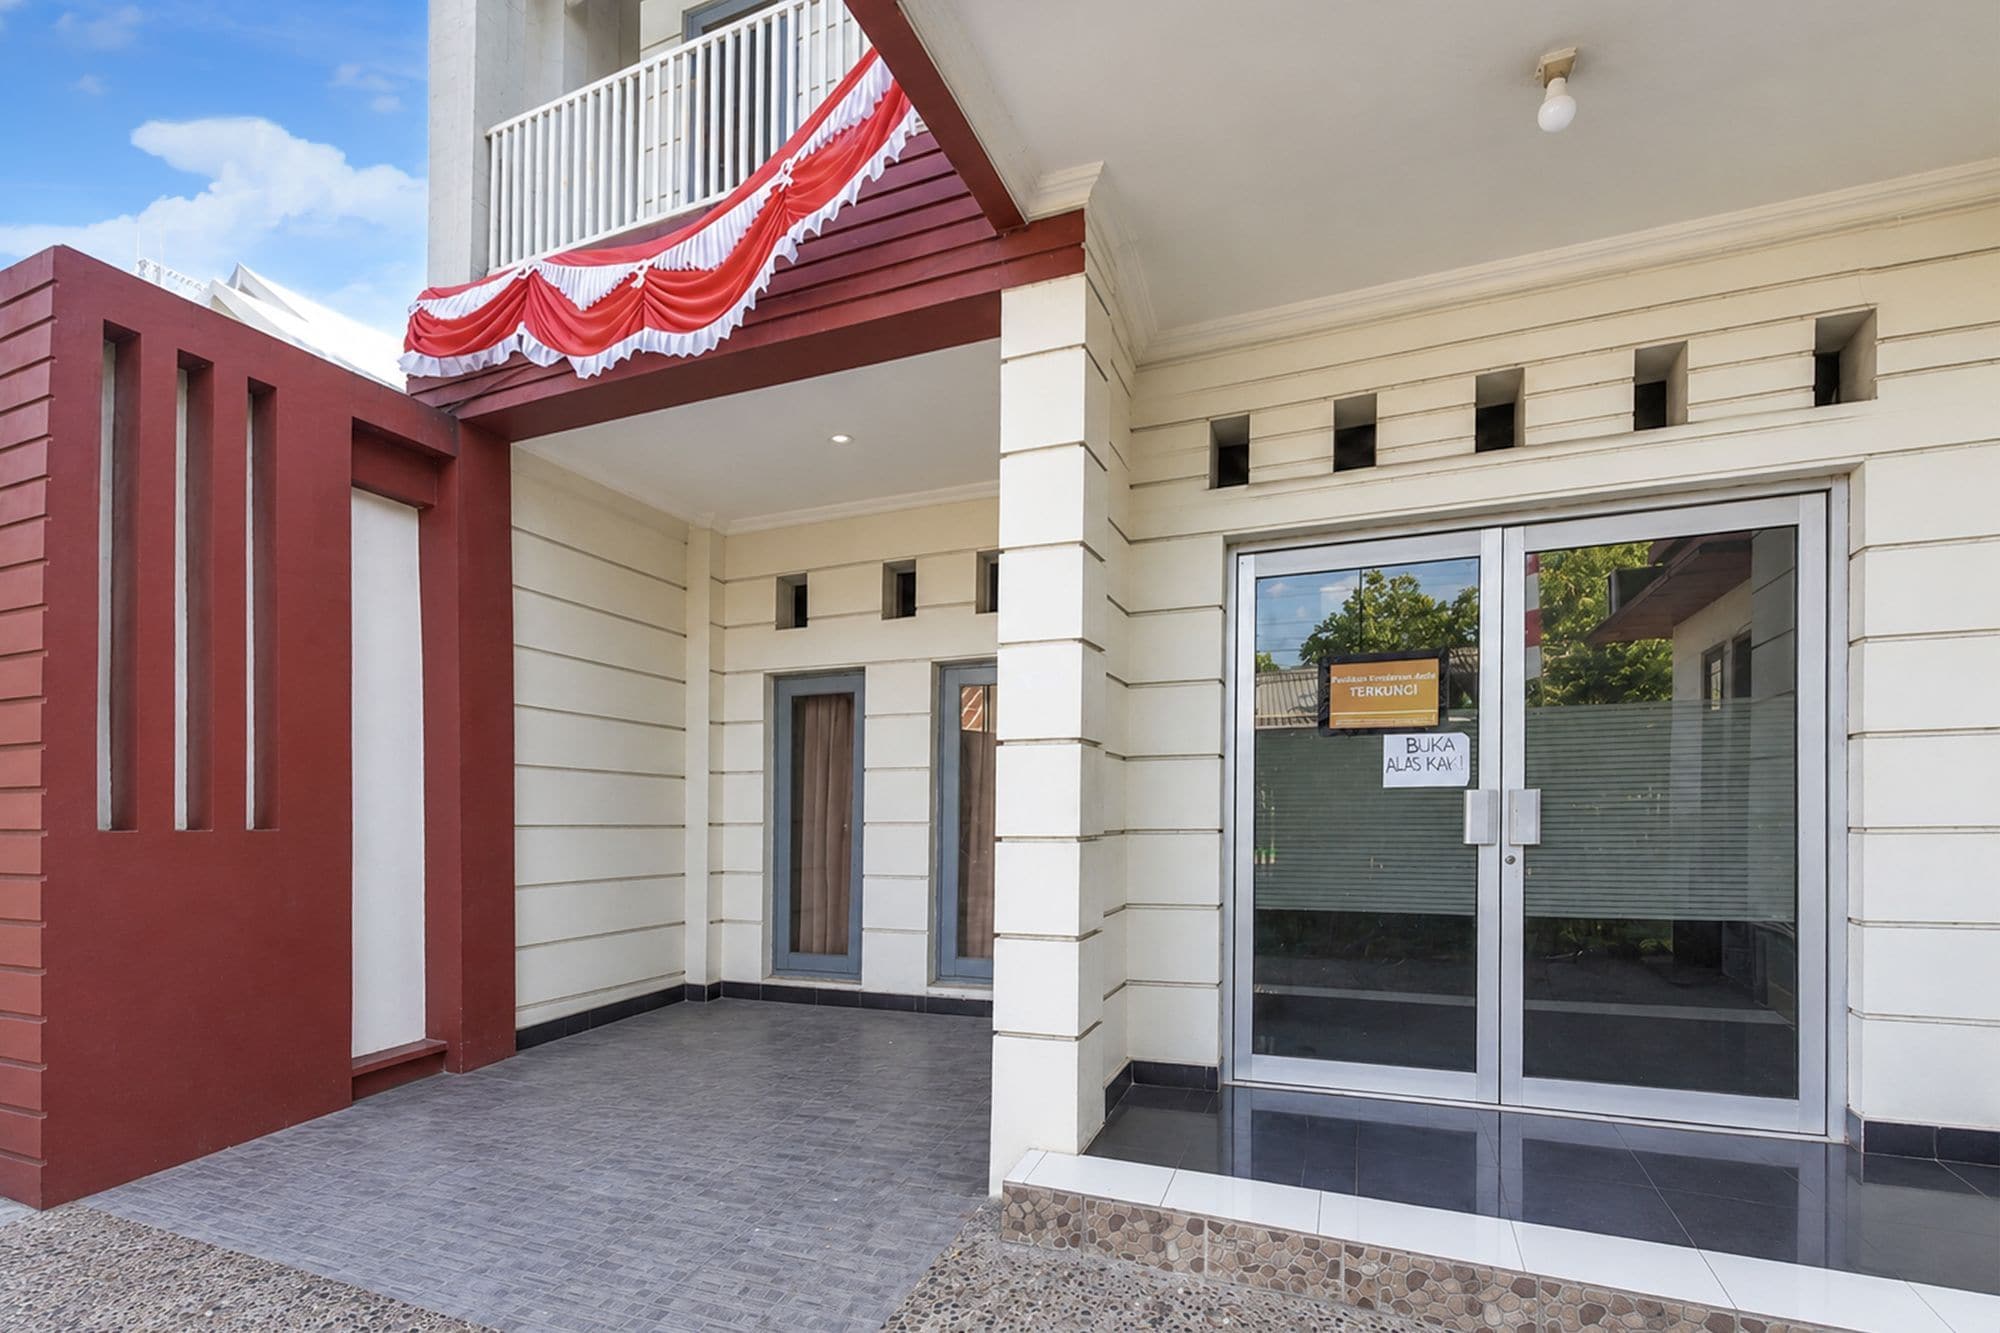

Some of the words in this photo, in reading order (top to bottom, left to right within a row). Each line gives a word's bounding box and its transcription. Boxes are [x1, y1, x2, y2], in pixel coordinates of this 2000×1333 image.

[1350, 684, 1418, 697] TERKUNCI
[1406, 736, 1455, 753] BUKA
[1386, 756, 1422, 774] ALAS
